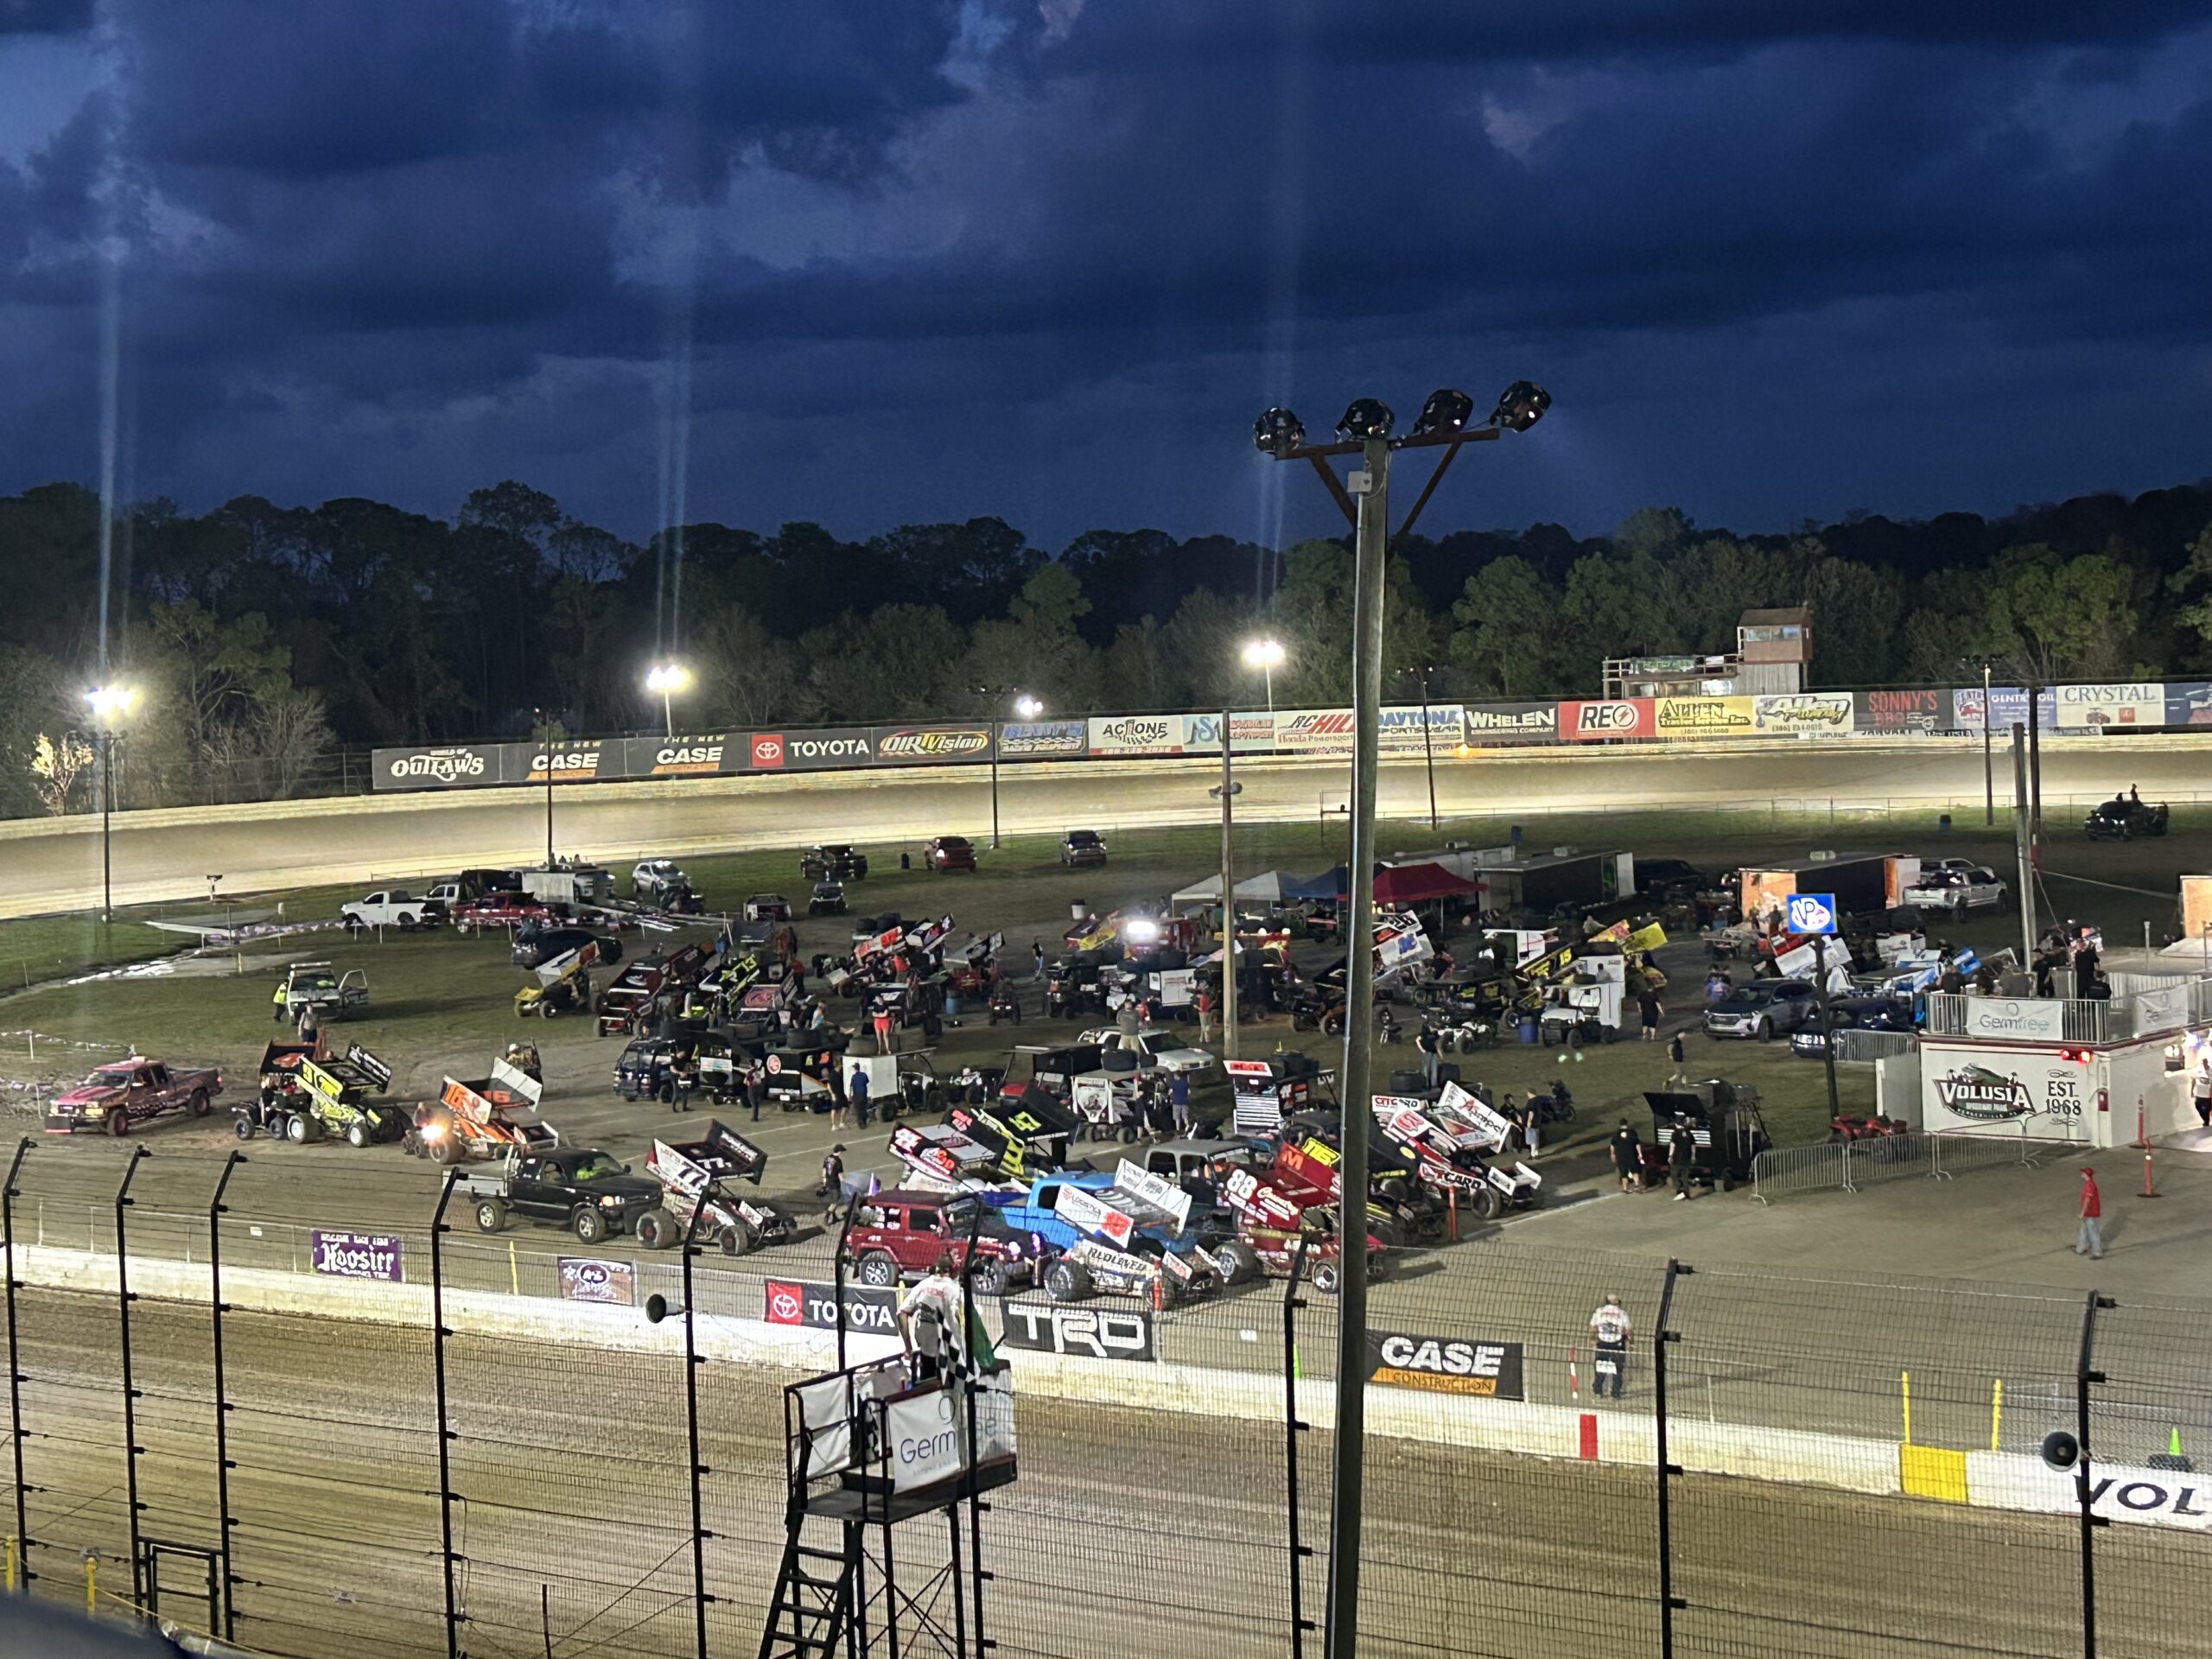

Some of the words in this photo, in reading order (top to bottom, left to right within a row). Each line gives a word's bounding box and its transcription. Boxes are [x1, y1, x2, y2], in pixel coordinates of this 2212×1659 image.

[1868, 691, 1938, 712] SONNY'S
[2065, 686, 2156, 702] CRYSTAL
[1466, 708, 1555, 728] WHELEN
[1661, 699, 1725, 718] ALLEN
[657, 747, 723, 764] CASE
[790, 740, 870, 757] TOYOTA
[532, 753, 600, 771] CASE
[1980, 1014, 2050, 1031] Germfree
[1940, 1082, 2031, 1109] VOLUSIA
[2046, 1099, 2082, 1116] 1968
[1227, 1169, 1257, 1199] 88
[317, 1243, 394, 1271] Hoosier
[1008, 1303, 1146, 1357] TRD
[1382, 1336, 1504, 1376] CASE
[1393, 1371, 1493, 1392] CONSTRUCTION
[2073, 1474, 2208, 1516] VOL
